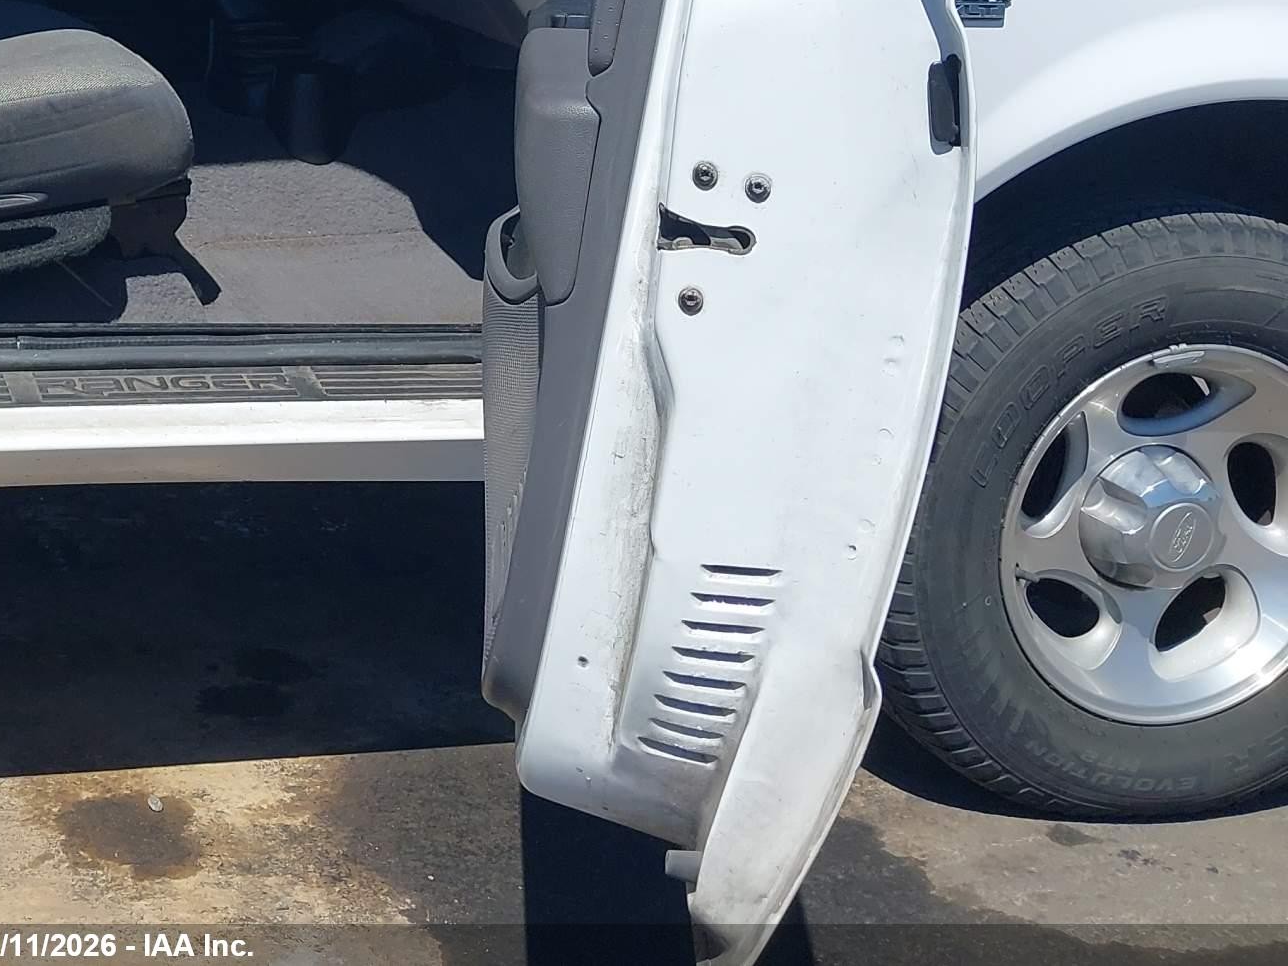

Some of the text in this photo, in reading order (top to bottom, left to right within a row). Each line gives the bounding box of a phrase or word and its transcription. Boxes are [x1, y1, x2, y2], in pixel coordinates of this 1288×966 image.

[40, 374, 288, 396] RANGER
[971, 296, 1169, 488] COOPER
[1024, 740, 1198, 791] EVOLUTION
